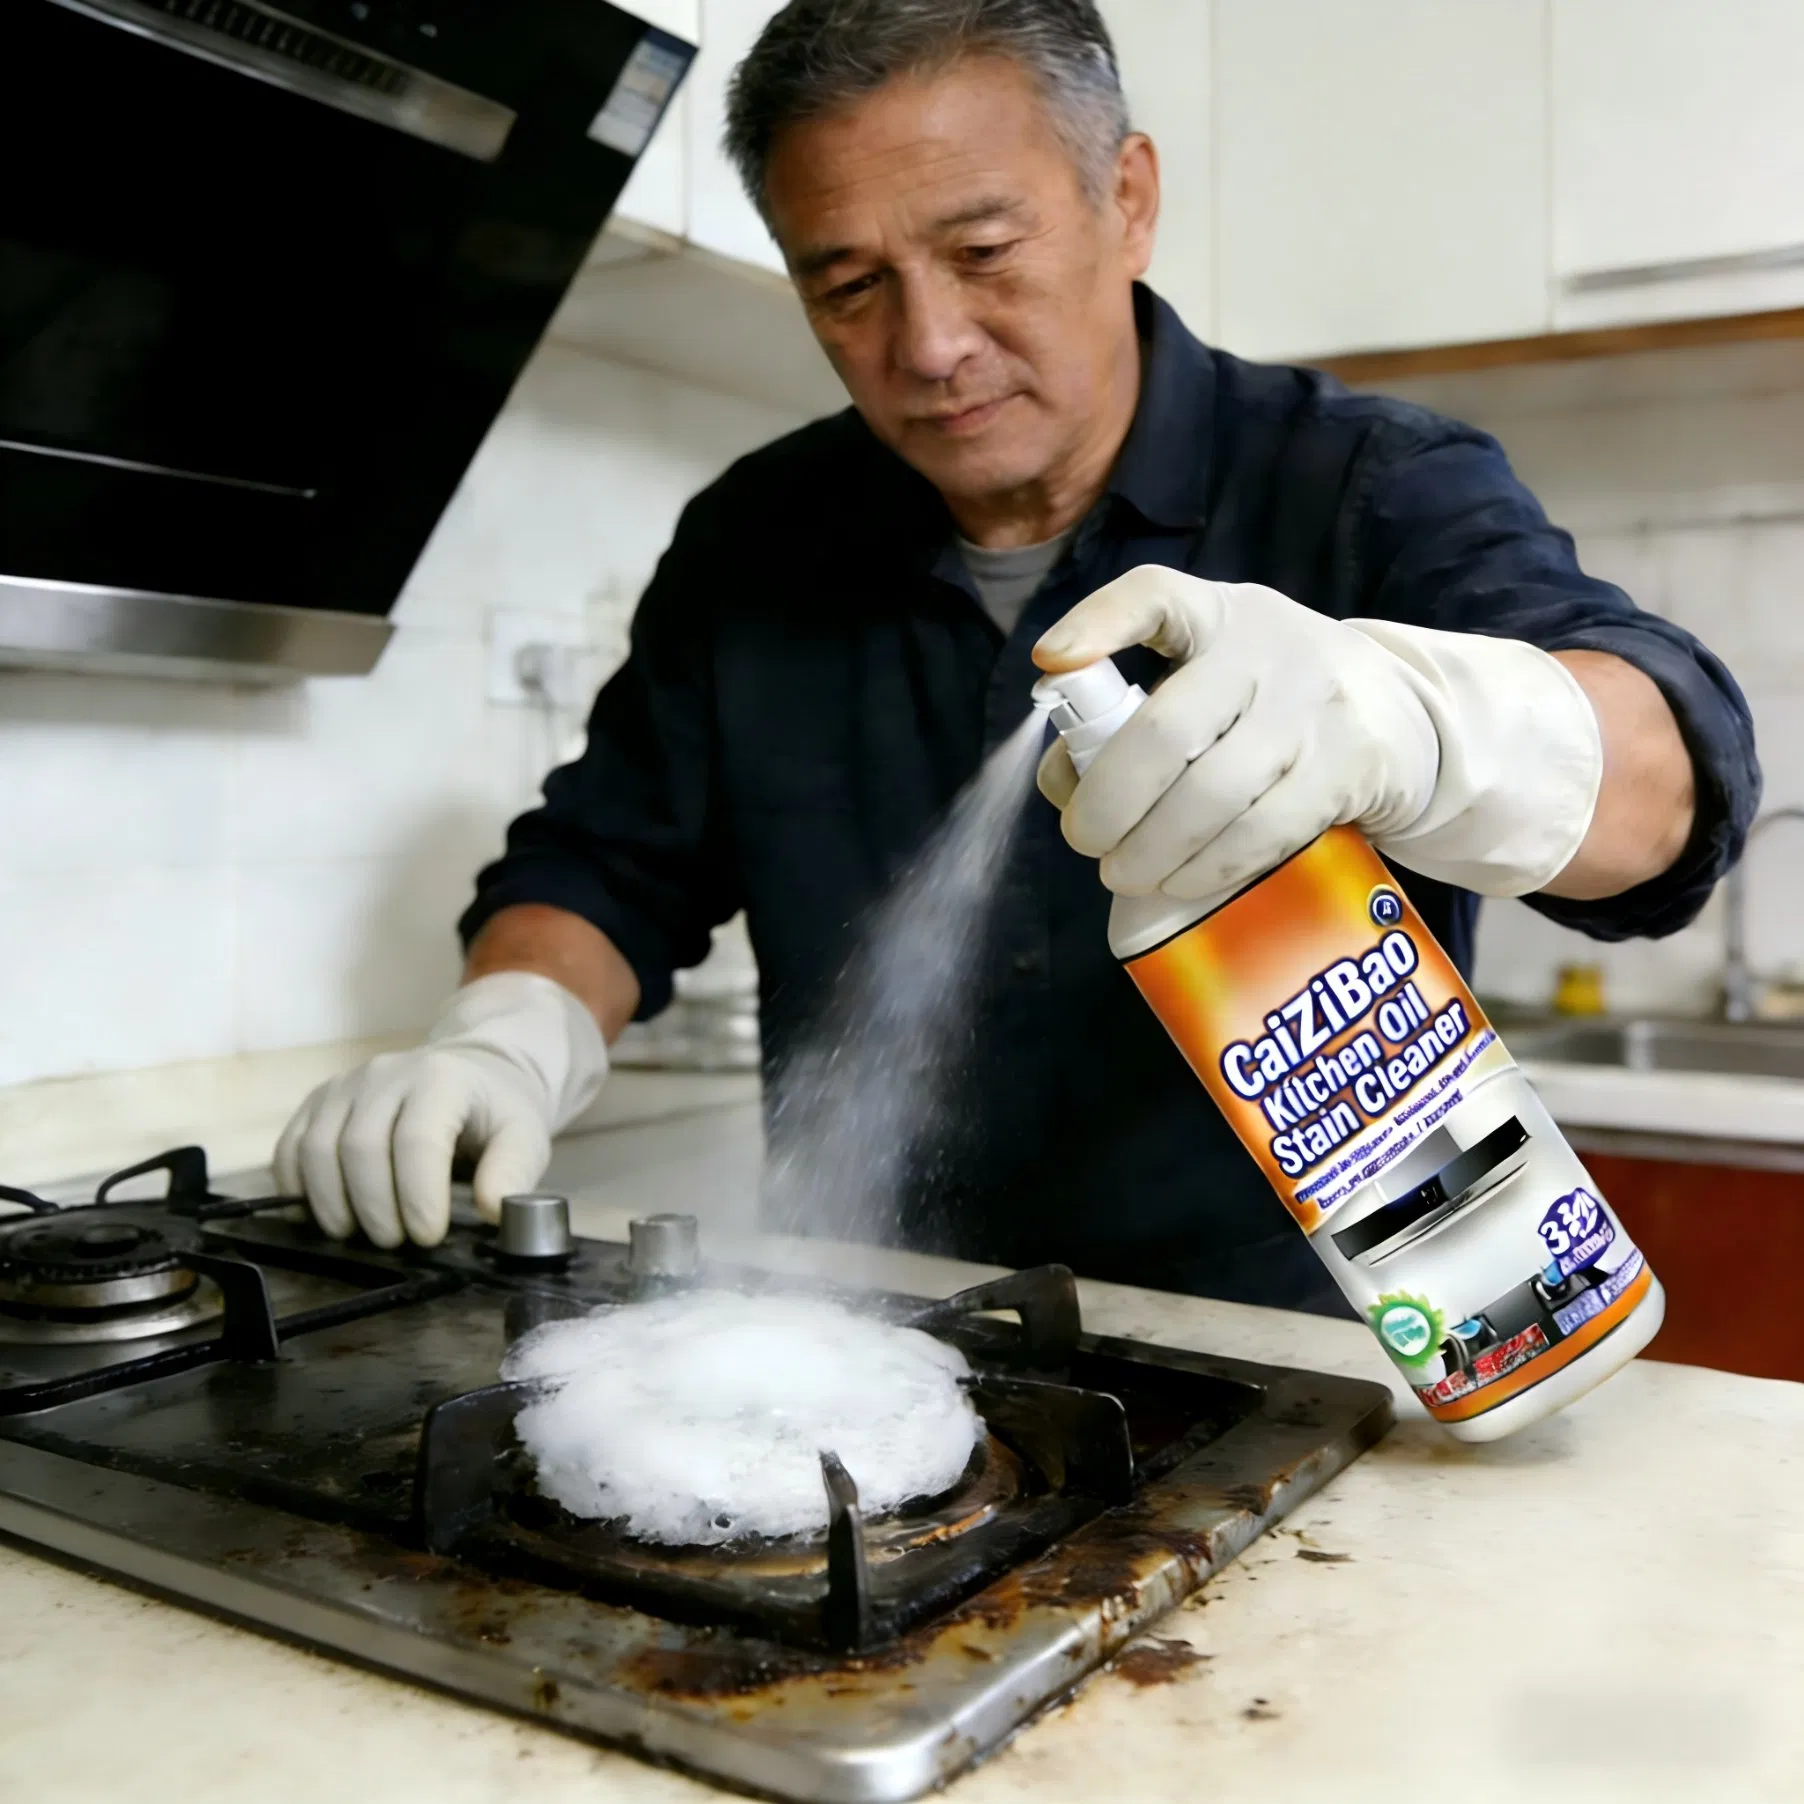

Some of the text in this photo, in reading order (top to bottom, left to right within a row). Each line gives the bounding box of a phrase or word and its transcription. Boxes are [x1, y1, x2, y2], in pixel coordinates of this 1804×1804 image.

[1222, 930, 1416, 1098] CaiZiBao
[1262, 1032, 1382, 1132] Kitchen
[1377, 982, 1430, 1043] Oil
[1272, 1101, 1361, 1175] Stain
[1354, 1002, 1466, 1114] Cleaner
